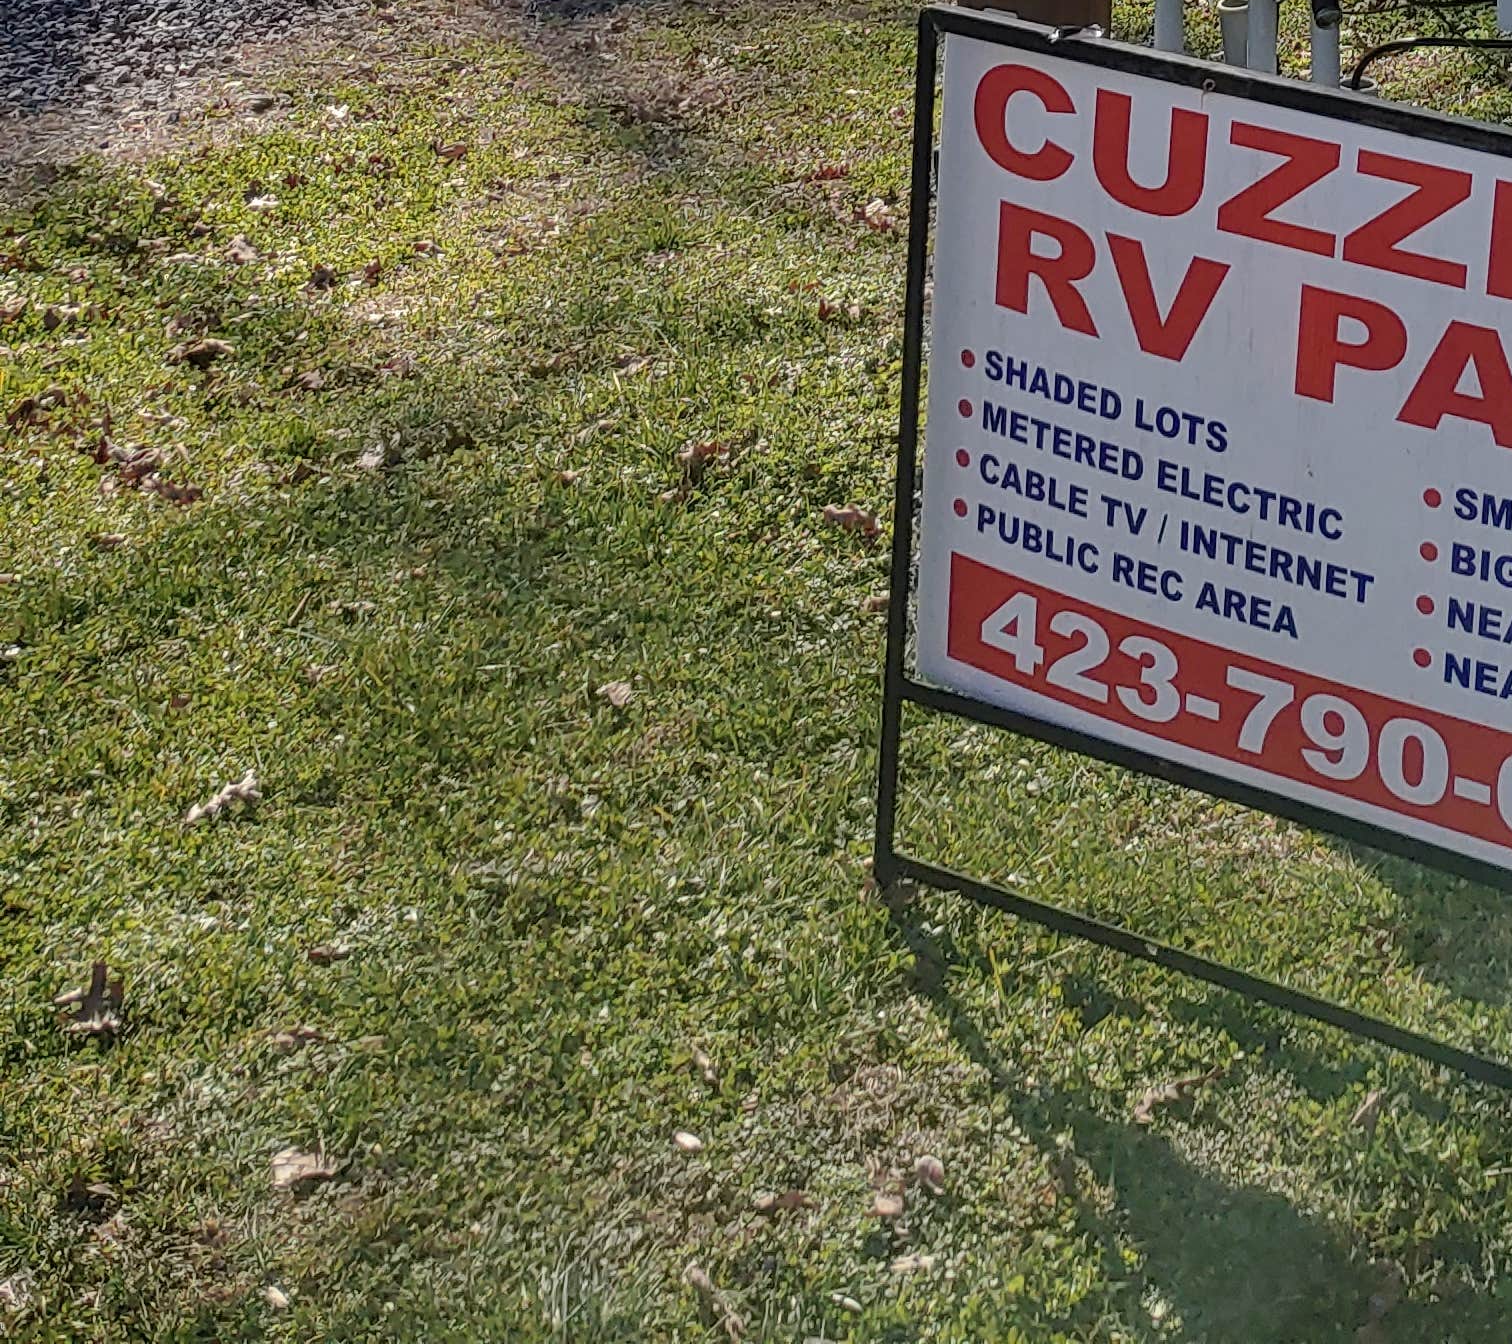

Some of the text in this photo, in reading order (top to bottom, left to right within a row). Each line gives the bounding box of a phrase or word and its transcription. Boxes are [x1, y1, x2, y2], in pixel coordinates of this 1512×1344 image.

[996, 201, 1230, 362] RV
[982, 400, 1343, 541] METERED ELECTRIC
[984, 349, 1228, 453] SHADED LOTS
[976, 503, 1299, 640] PUBLIC REC AREA
[979, 453, 1375, 604] CABLE TV / INTERNET
